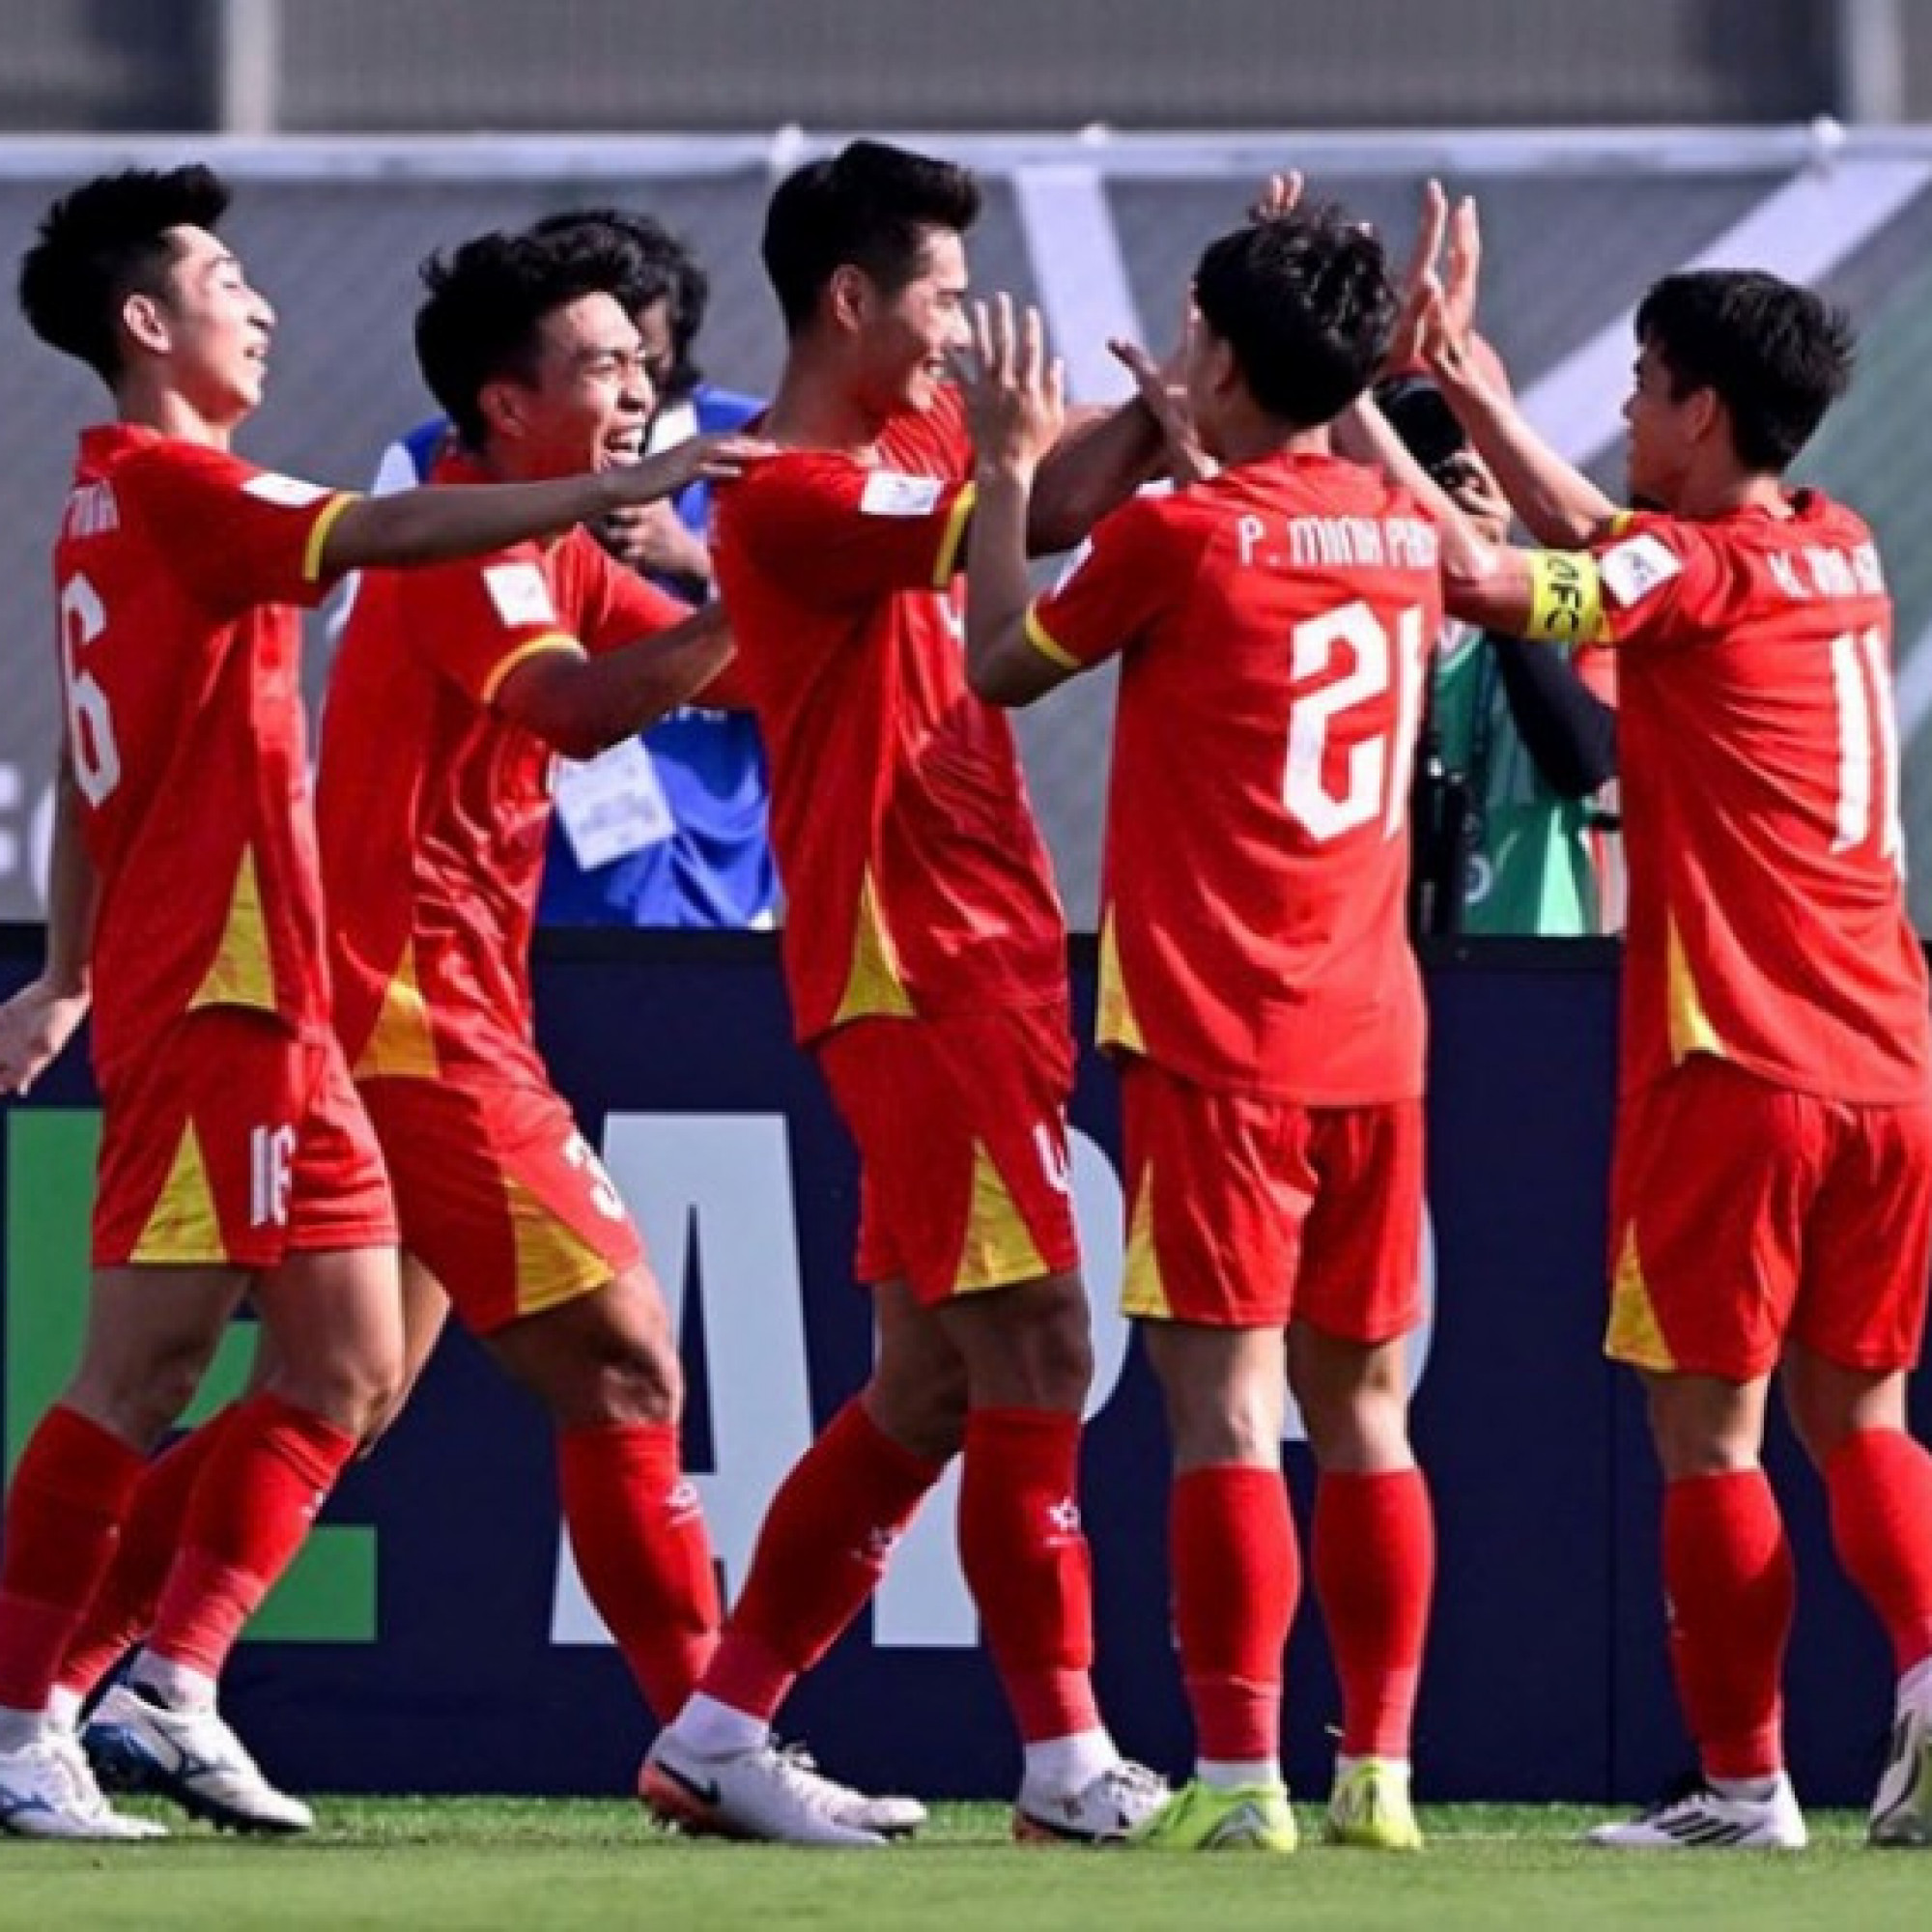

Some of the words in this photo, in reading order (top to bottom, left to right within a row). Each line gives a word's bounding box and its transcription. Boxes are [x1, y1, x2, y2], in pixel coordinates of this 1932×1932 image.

[1237, 516, 1281, 565] P.
[1546, 556, 1582, 632] AFC
[1282, 599, 1426, 843] 21
[1830, 625, 1900, 860] 11
